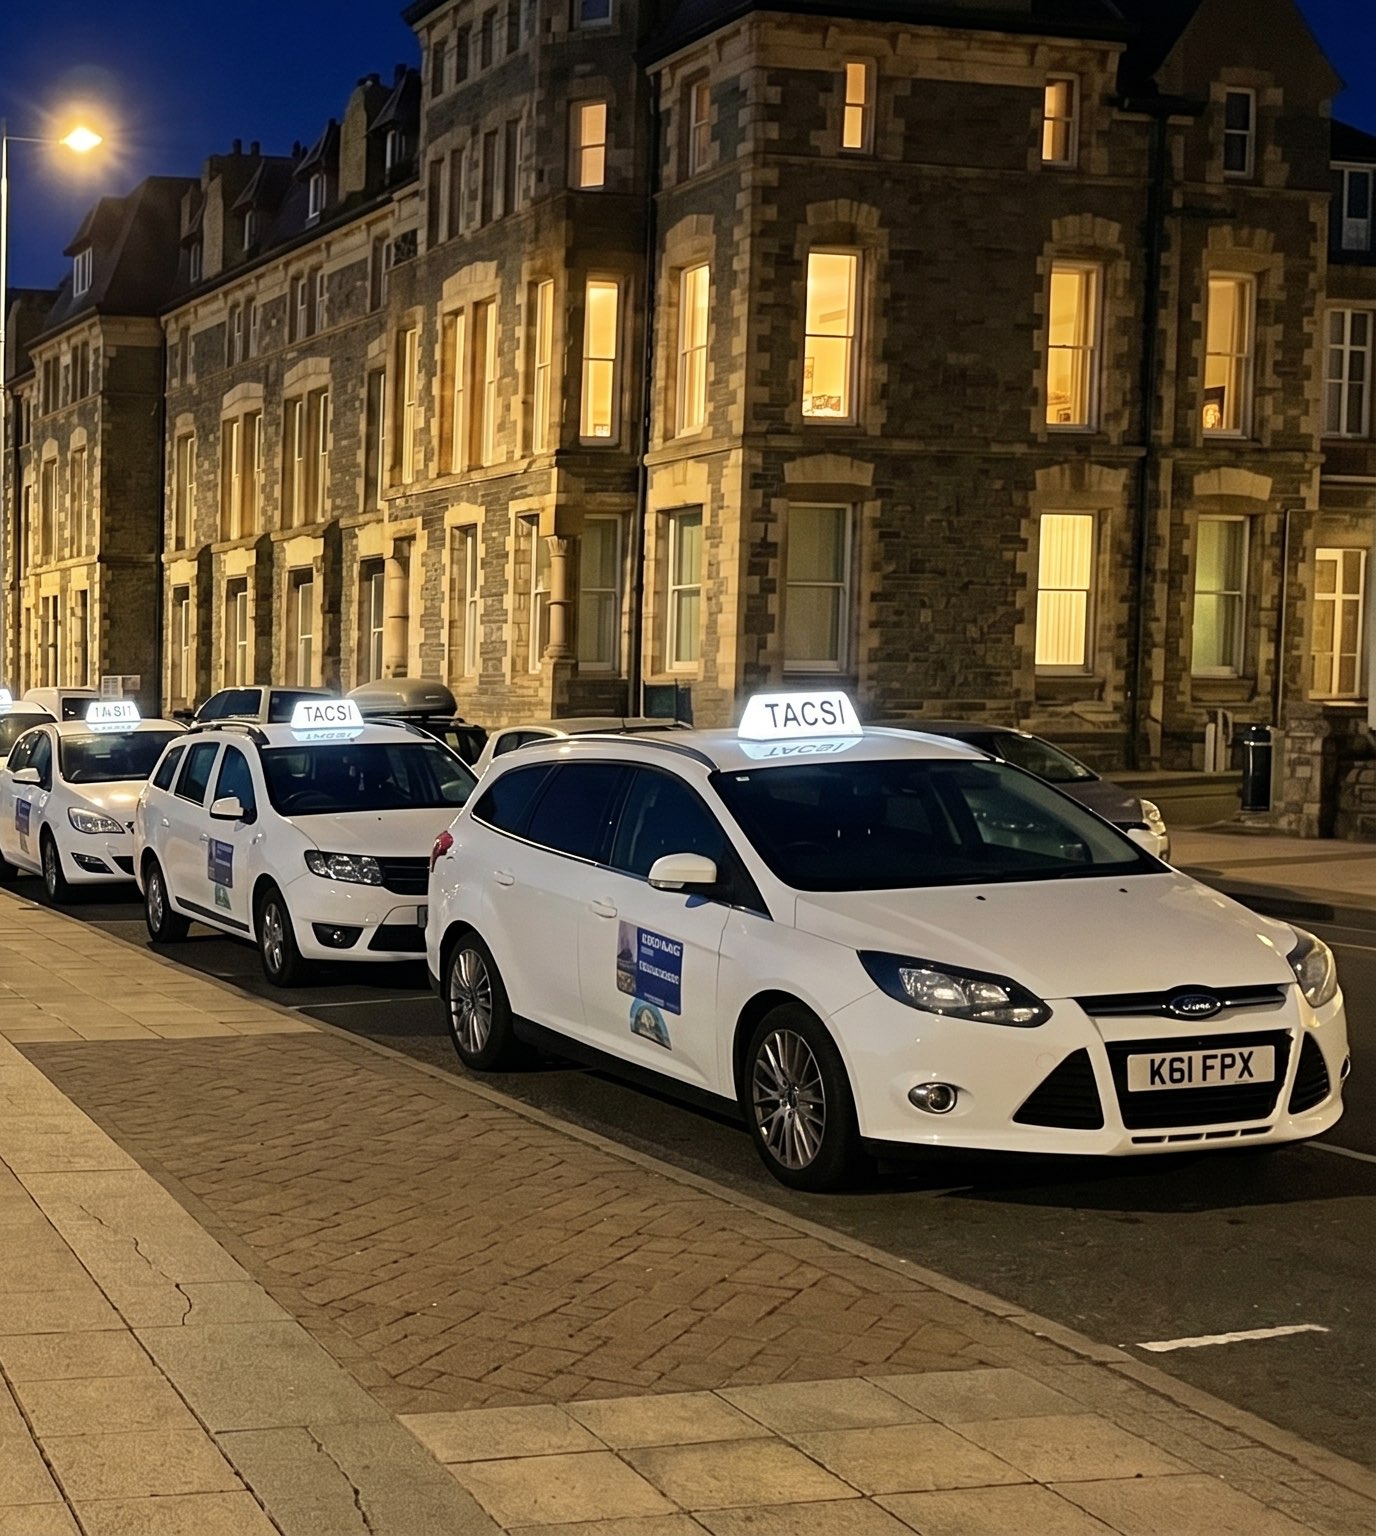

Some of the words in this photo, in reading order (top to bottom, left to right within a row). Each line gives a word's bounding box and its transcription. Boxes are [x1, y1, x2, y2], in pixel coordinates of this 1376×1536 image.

[303, 705, 352, 722] TACSI
[765, 699, 845, 728] TACSI
[1202, 1051, 1254, 1082] FPX
